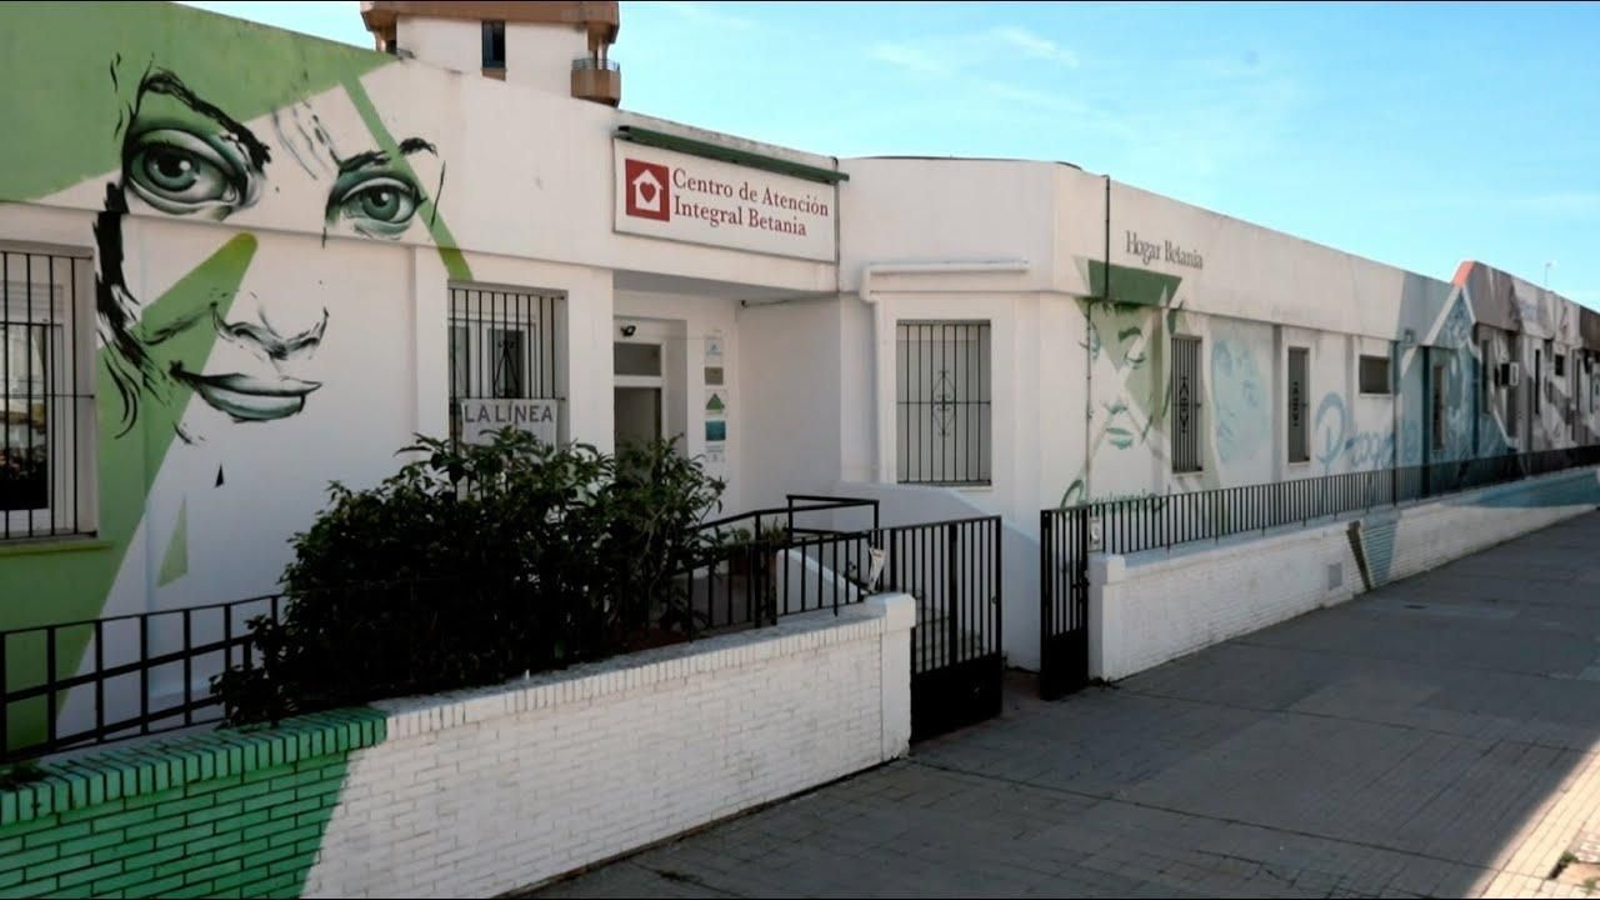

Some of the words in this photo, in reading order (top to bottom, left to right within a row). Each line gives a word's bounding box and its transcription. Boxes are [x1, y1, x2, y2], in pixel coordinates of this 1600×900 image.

[672, 168, 734, 198] Centro
[738, 181, 759, 203] de
[762, 187, 829, 217] Atención
[673, 194, 743, 227] Integral
[748, 208, 808, 236] Betania
[1126, 229, 1160, 266] Hogar
[1164, 239, 1204, 270] Betania
[463, 404, 491, 422] LA
